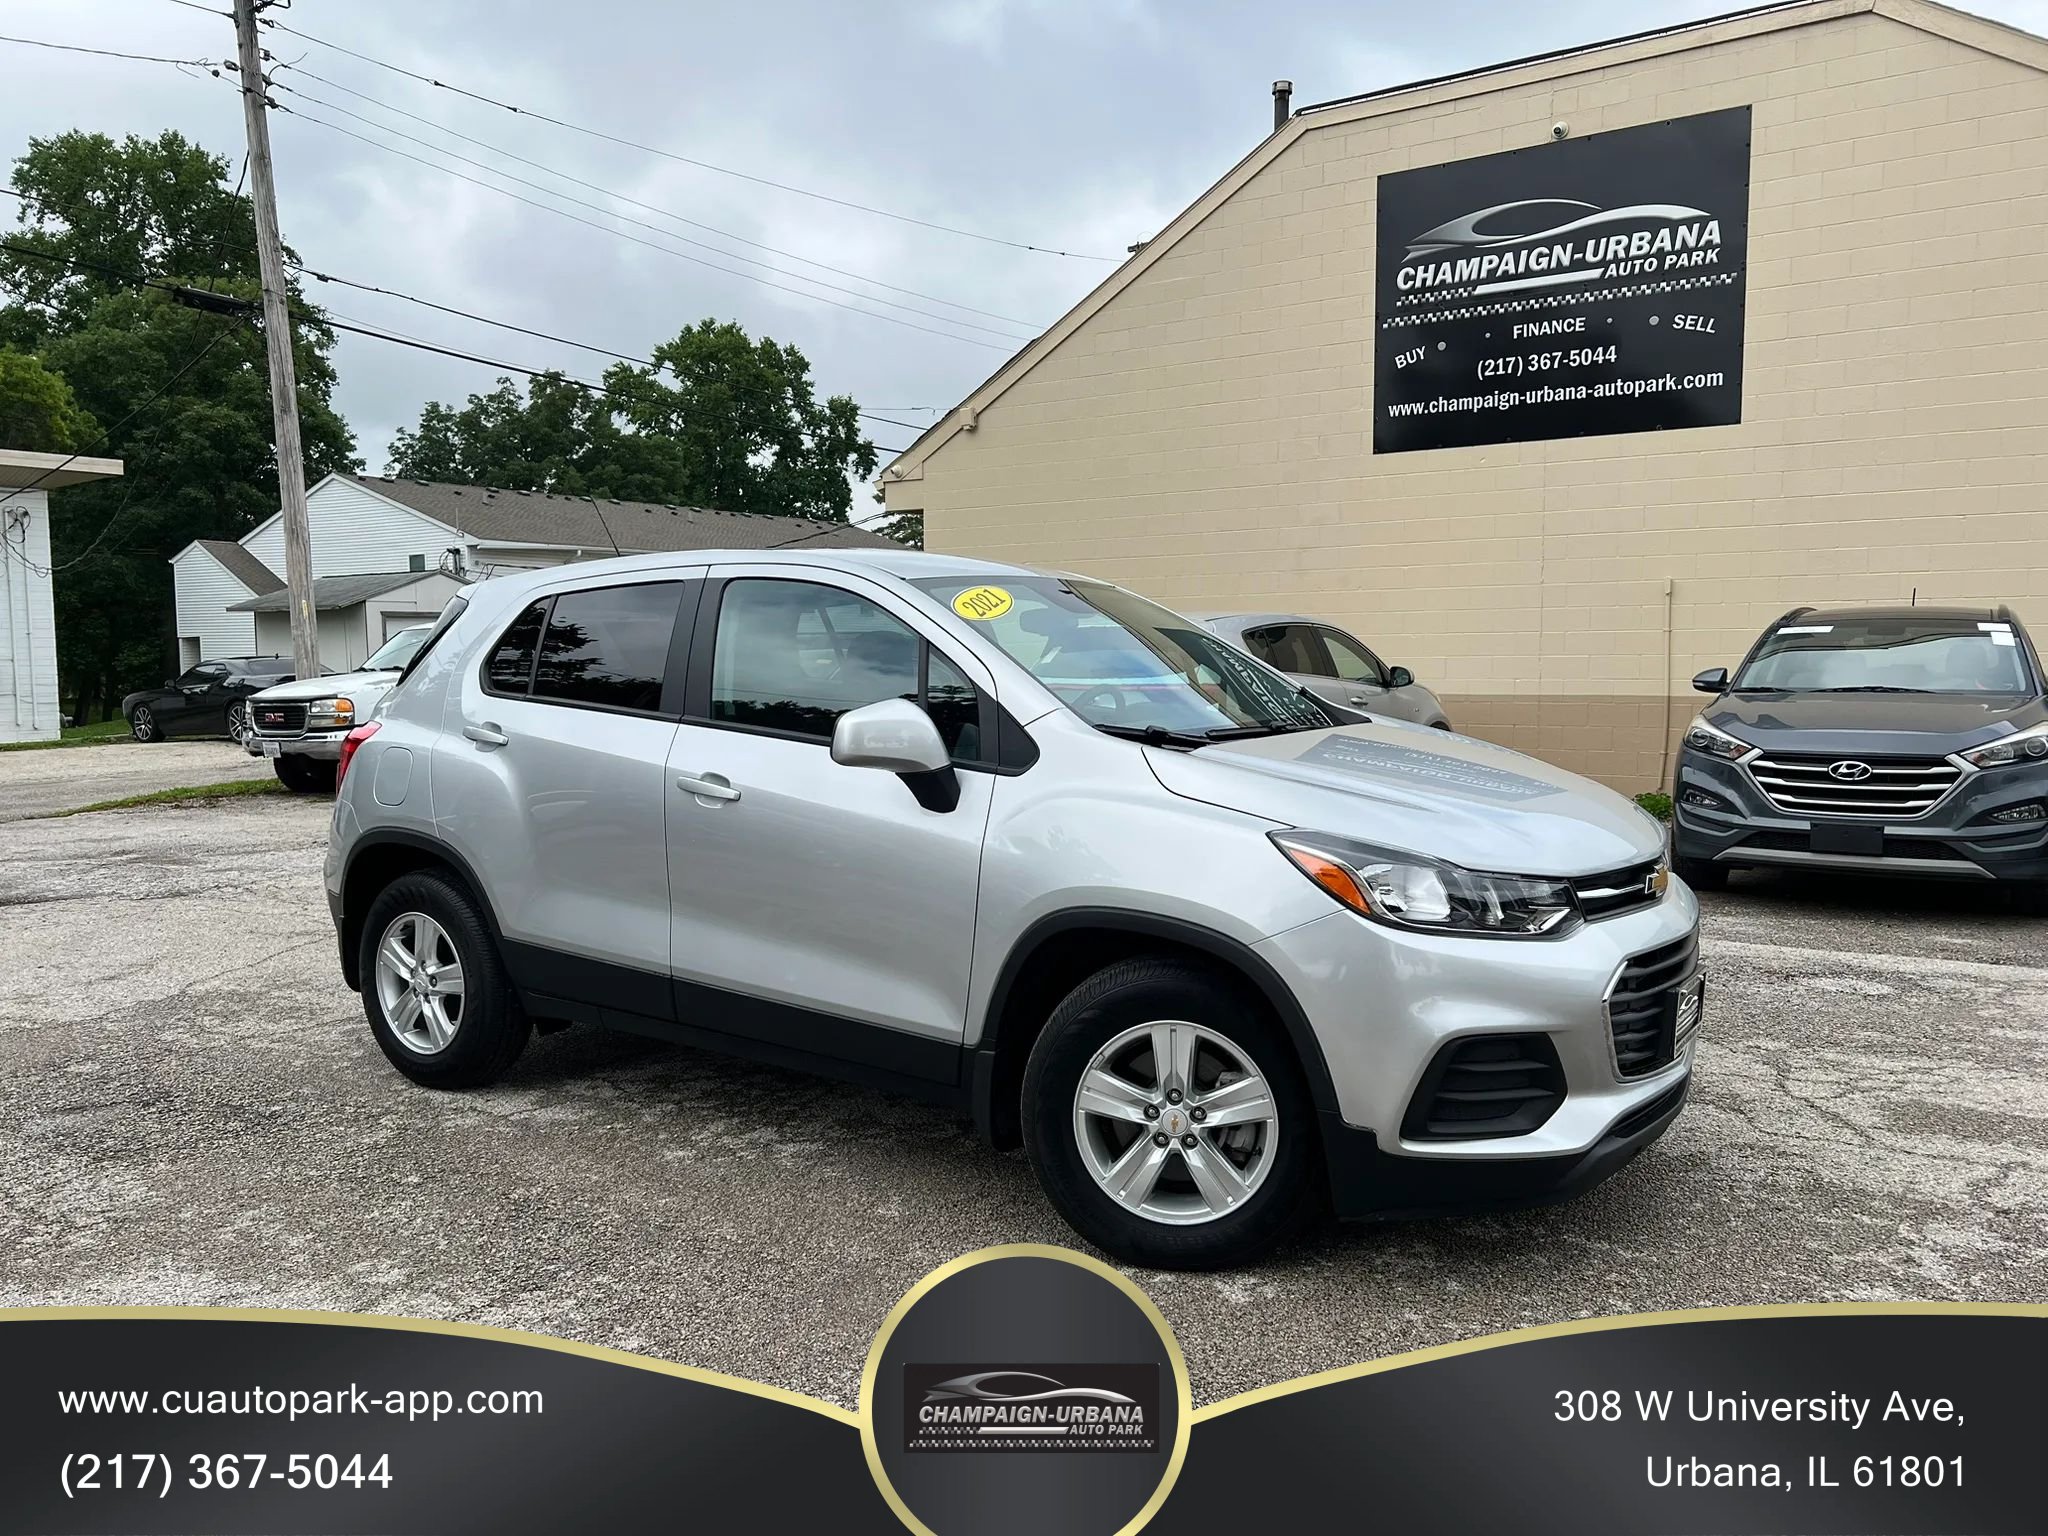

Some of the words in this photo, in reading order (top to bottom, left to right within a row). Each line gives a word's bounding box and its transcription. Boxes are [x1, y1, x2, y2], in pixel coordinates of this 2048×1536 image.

[1396, 219, 1722, 291] CHAMPAIGN-URBANA
[1604, 257, 1658, 279] AUTO
[1664, 247, 1721, 270] PARK
[1394, 345, 1426, 369] BUY
[1513, 316, 1587, 340] FINANCE
[1672, 314, 1717, 334] SELL
[1476, 355, 1524, 381] (217)
[1527, 344, 1618, 372] 367-5044
[1387, 369, 1724, 418] www.champaign-urbana-autopark.com
[961, 588, 1007, 618] 2021
